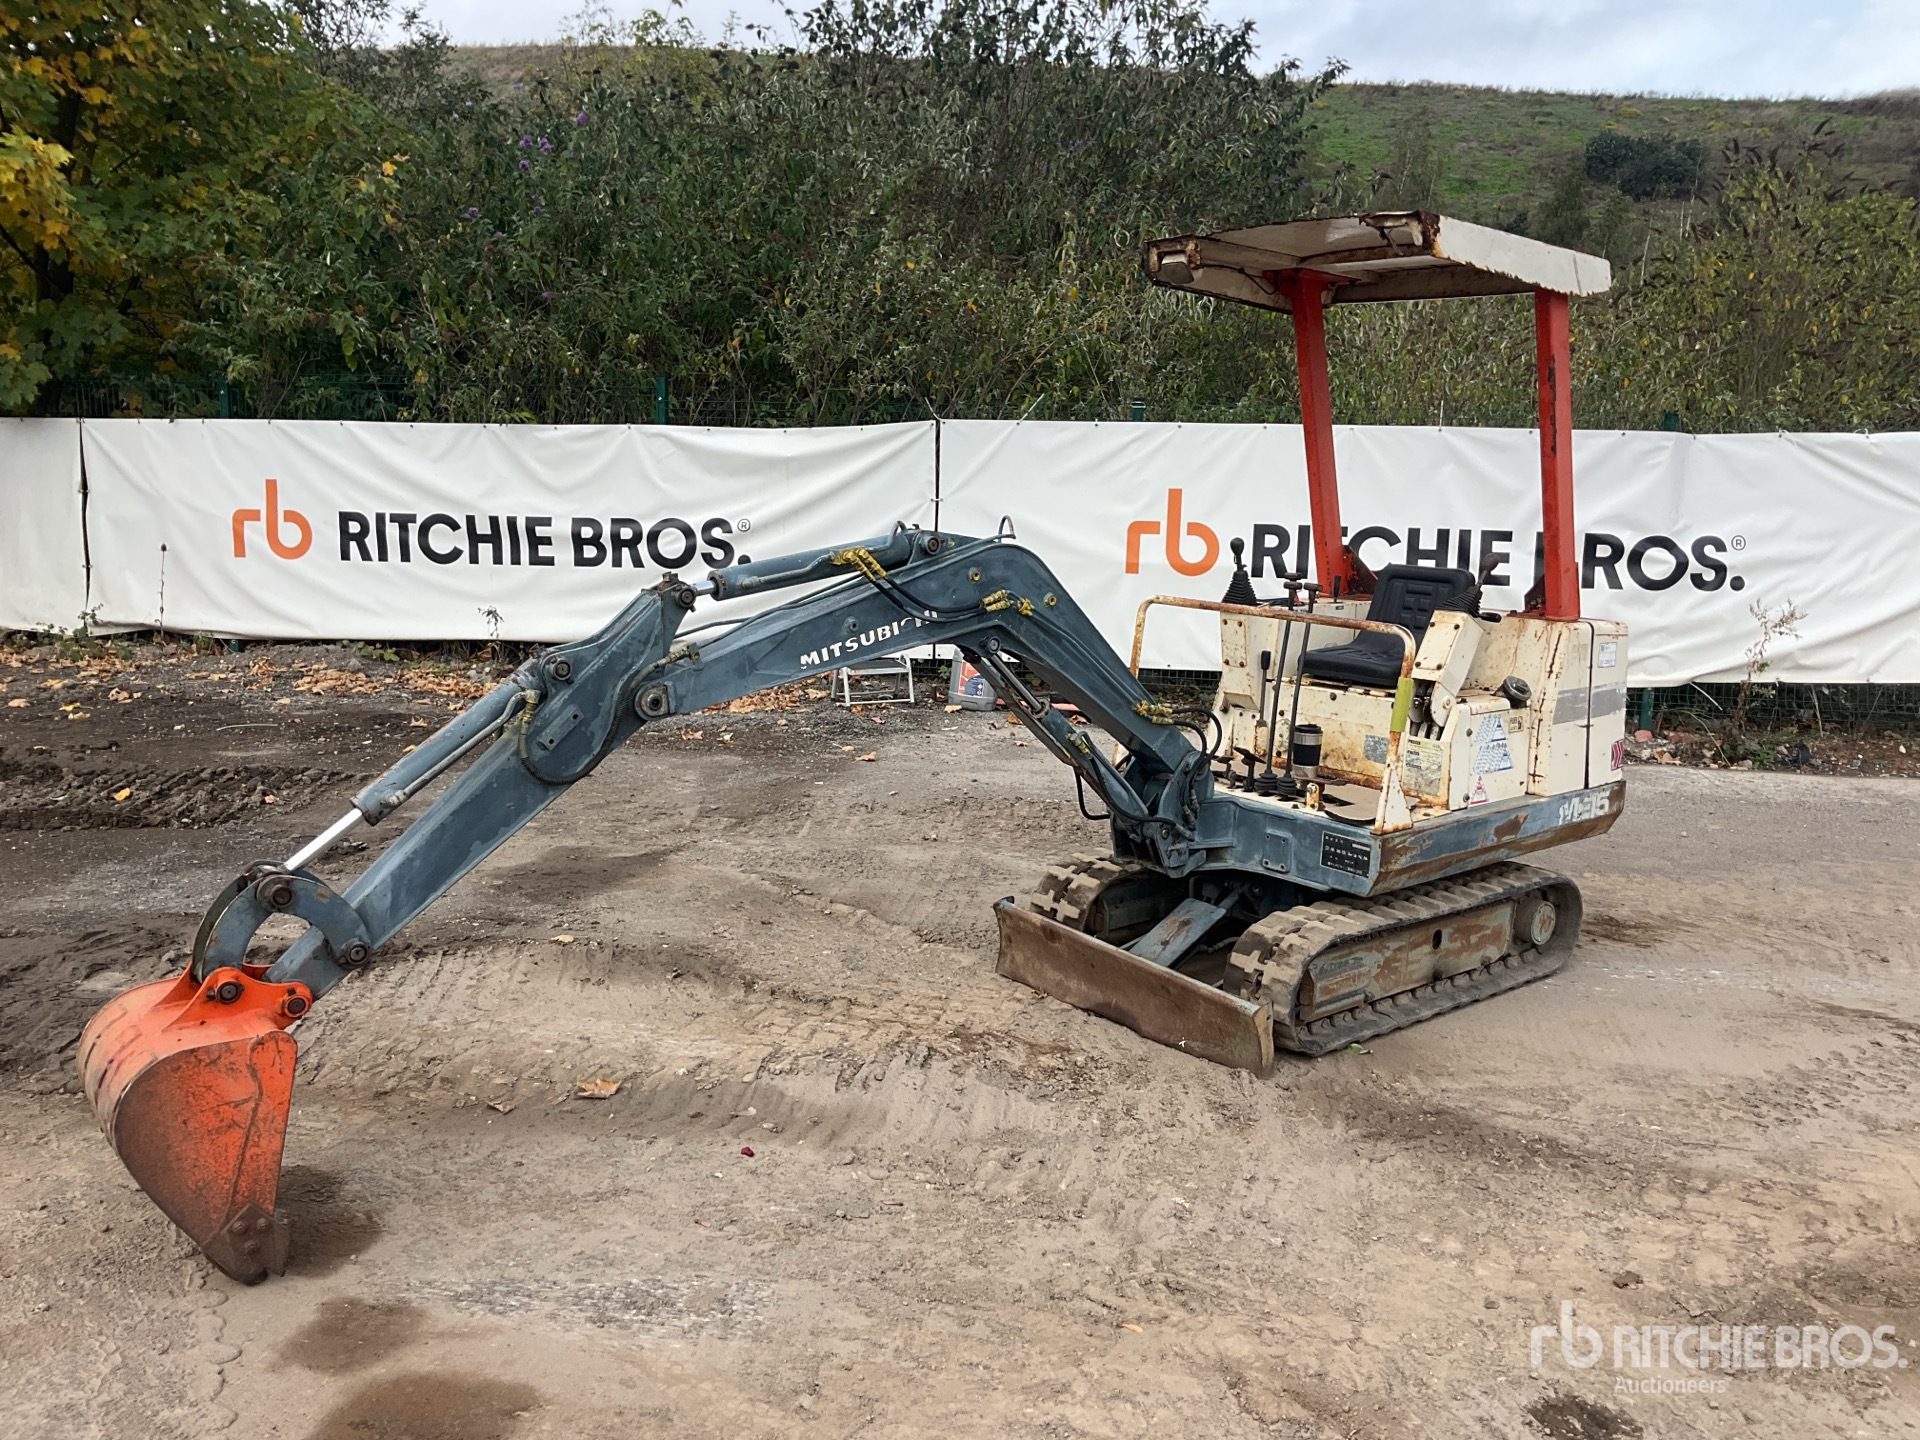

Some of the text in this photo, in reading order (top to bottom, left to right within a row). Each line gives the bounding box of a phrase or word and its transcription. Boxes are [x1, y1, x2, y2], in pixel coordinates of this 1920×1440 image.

[232, 479, 313, 560] rb
[338, 511, 555, 566] RITCHIE
[1125, 488, 1220, 577] rb
[1250, 523, 1513, 587] RICHIE
